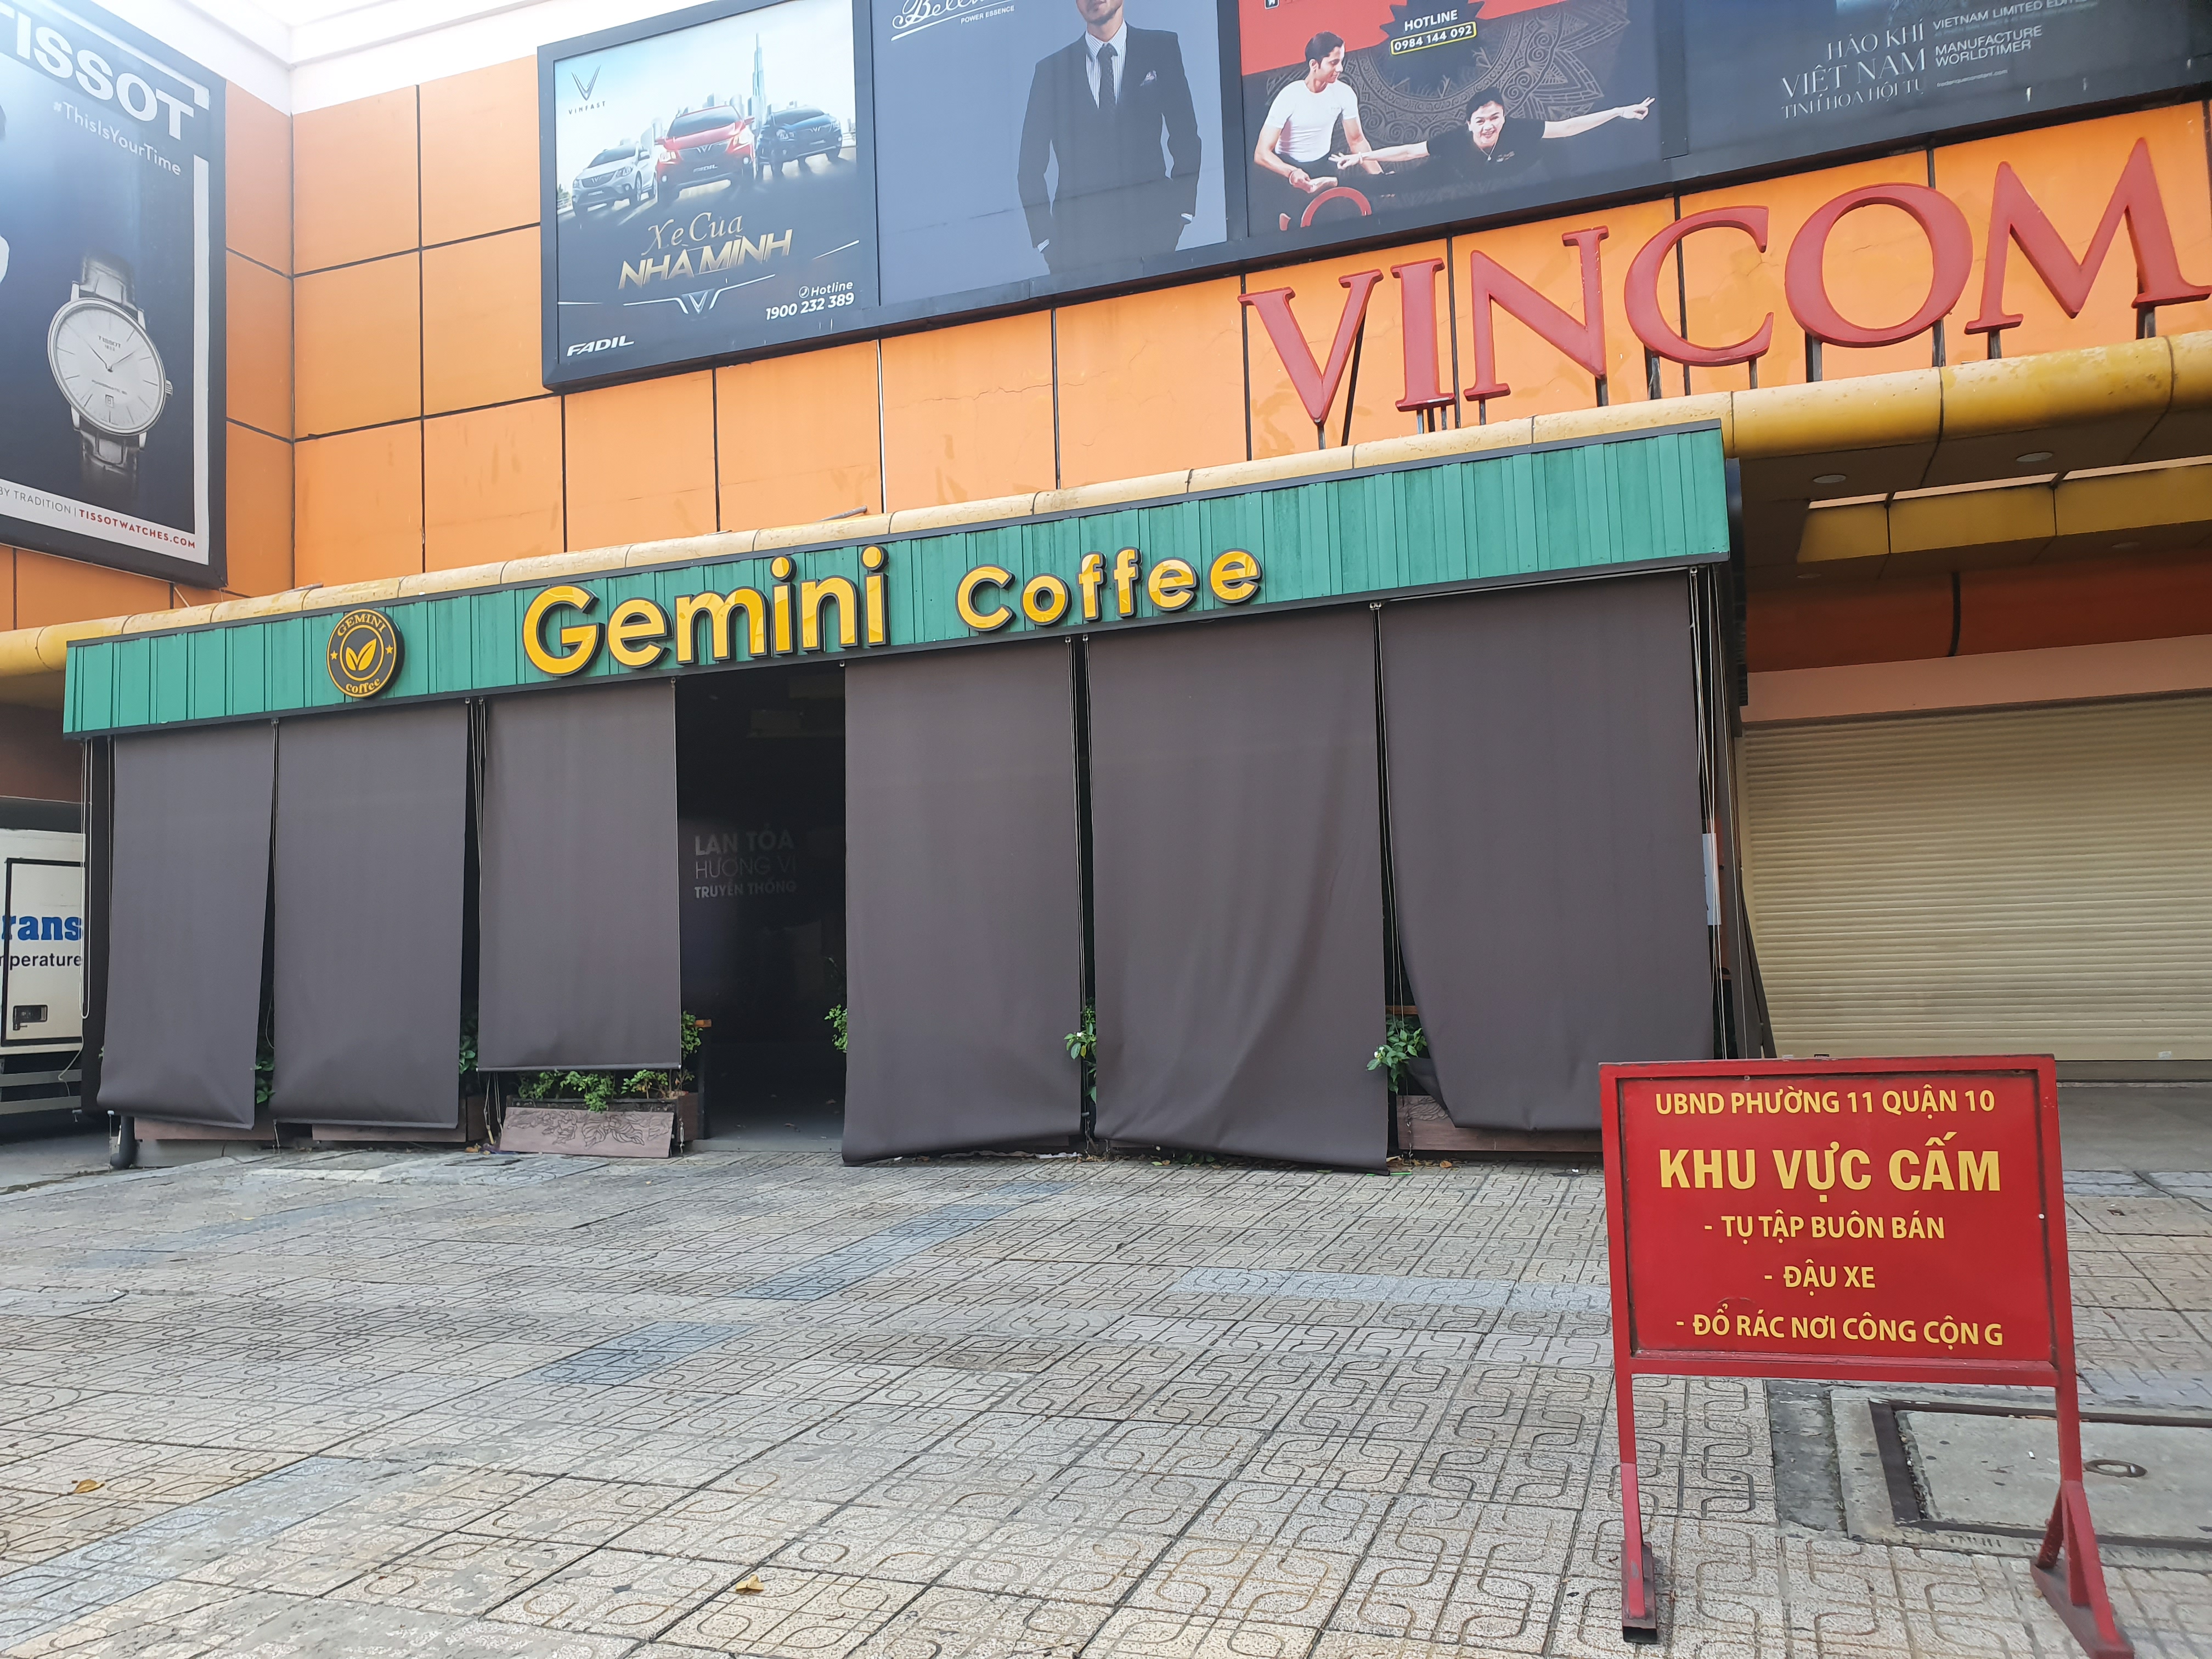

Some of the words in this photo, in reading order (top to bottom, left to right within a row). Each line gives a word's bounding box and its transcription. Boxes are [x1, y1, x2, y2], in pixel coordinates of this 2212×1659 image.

[961, 13, 984, 25] POWER
[985, 5, 1015, 18] ESSENCE
[1404, 9, 1458, 32] HOTLINE
[1933, 10, 1989, 30] VIETNAM
[1993, 0, 2043, 18] LIMITED
[1394, 37, 1424, 52] 0984
[1426, 31, 1448, 44] 144
[1451, 25, 1472, 38] 092
[1886, 18, 1923, 48] KHÍ
[1935, 25, 2042, 56] MANUFACTURE
[1857, 48, 1926, 84] NAM
[1936, 40, 2032, 67] WORLDTIMER
[568, 100, 605, 115] VINFAST
[1826, 91, 1864, 110] HOA
[1869, 82, 1899, 102] HỘI
[53, 101, 182, 176] #ThisIsYourTime
[641, 218, 684, 256] Xe
[618, 244, 695, 290] NHÀ
[1239, 137, 2212, 426] VINCOM
[811, 281, 854, 297] Hotline
[766, 303, 798, 320] 1900
[800, 297, 825, 314] 232
[827, 292, 855, 308] 389
[567, 335, 635, 357] FADIL
[14, 490, 71, 514] TRADITION
[78, 509, 196, 549] TISSOTWATCHES.COM
[337, 613, 387, 637] GEMINI
[522, 544, 890, 678] Gemini
[345, 678, 381, 693] coffee
[695, 832, 738, 856] LAN
[1656, 1092, 1724, 1115] UBND
[1731, 1085, 1839, 1114] PHƯỜNG
[1847, 1092, 1872, 1113] 11
[1882, 1084, 1957, 1119] QUẬN
[1965, 1090, 1995, 1111] 10
[1660, 1149, 1756, 1189] KHU
[1772, 1141, 1871, 1203] VỰC
[1889, 1131, 2000, 1191] CẤM
[1721, 1216, 1753, 1244] TỤ
[1758, 1209, 1804, 1244] TẬP
[1811, 1210, 1884, 1238] BUÔN
[1892, 1210, 1944, 1239] BÁN
[1783, 1259, 1836, 1296] ĐẬU
[1843, 1266, 1876, 1288] XE
[1692, 1303, 1730, 1335] ĐỔ
[1737, 1309, 1785, 1338] RÁC
[1791, 1315, 1836, 1339] NƠI
[1843, 1312, 1916, 1342] CÔNG
